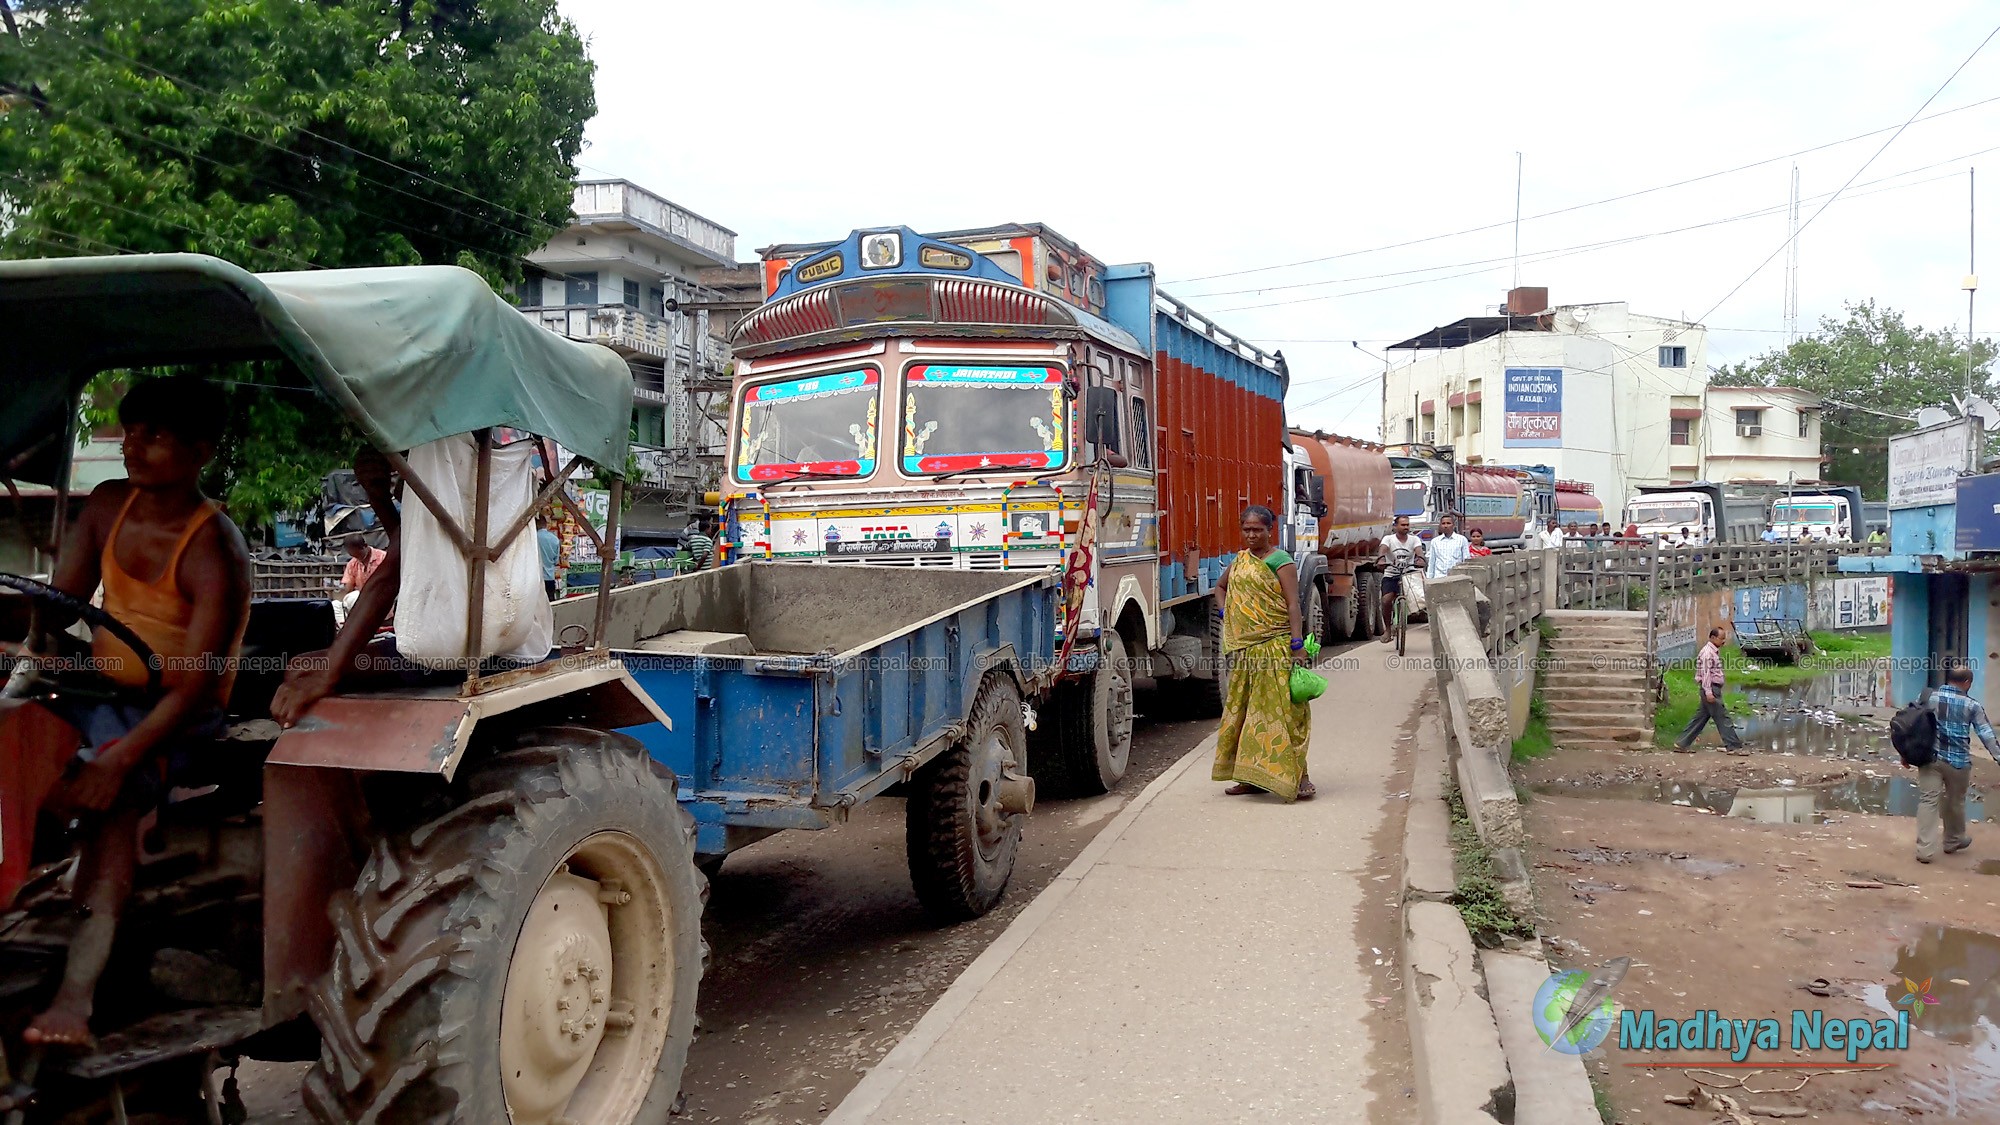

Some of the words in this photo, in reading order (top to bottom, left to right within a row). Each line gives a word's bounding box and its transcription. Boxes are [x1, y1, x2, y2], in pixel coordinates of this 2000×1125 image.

[801, 259, 839, 279] PUBLIC
[1508, 383, 1530, 393] INDIAN
[1530, 383, 1558, 393] CUSTOMS
[861, 526, 912, 540] TATA
